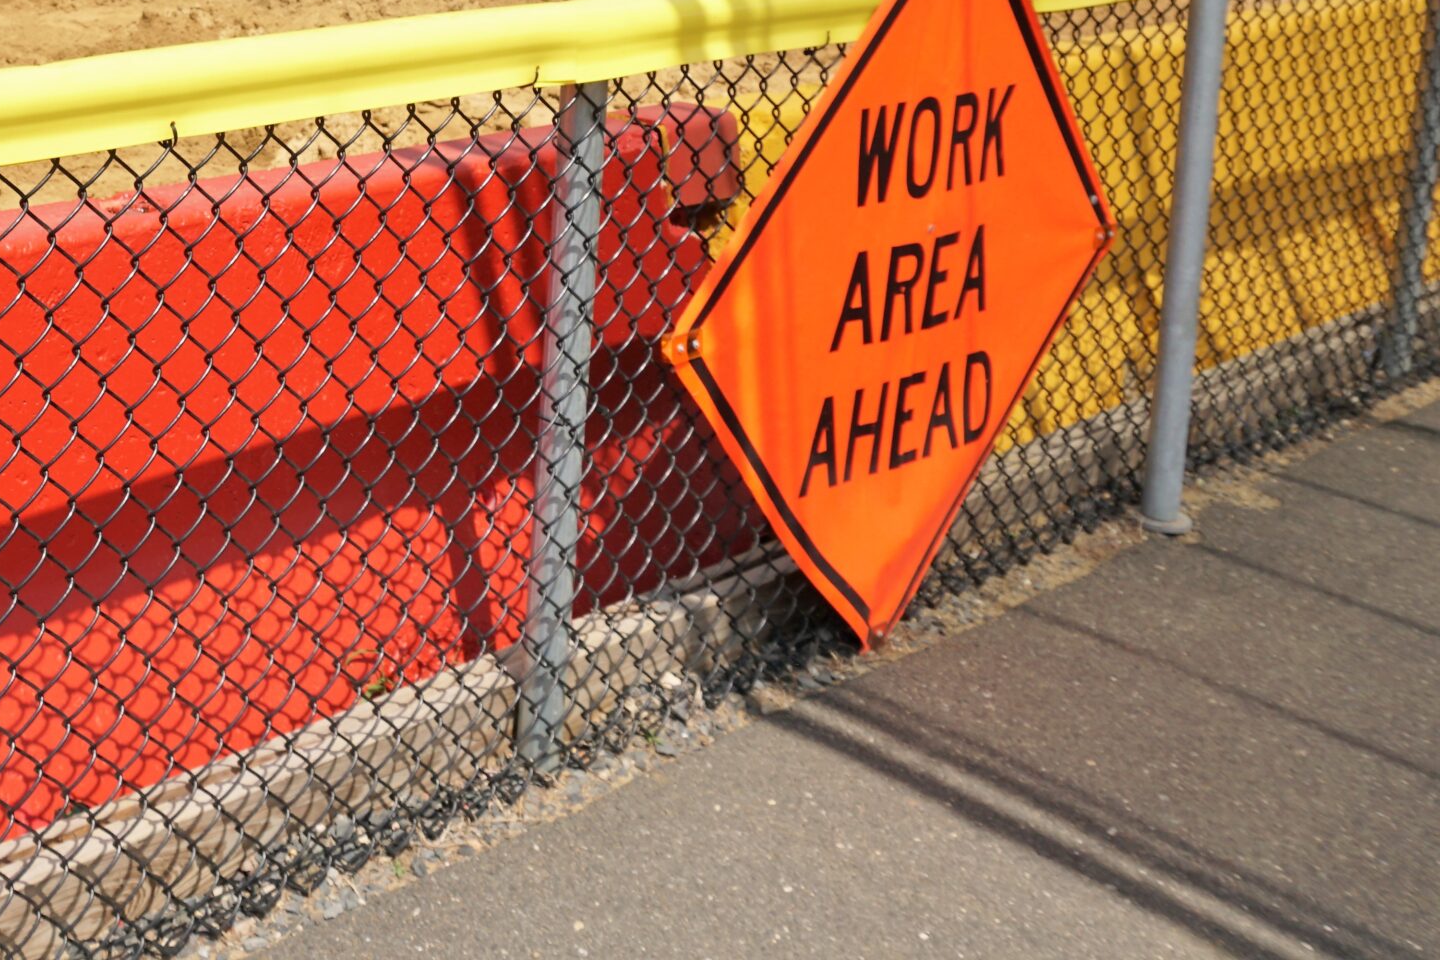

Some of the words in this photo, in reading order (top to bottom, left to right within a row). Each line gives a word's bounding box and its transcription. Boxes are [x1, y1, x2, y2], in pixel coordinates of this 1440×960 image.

[858, 84, 1016, 208] WORK
[829, 224, 985, 352] AREA
[798, 350, 992, 498] AHEAD
